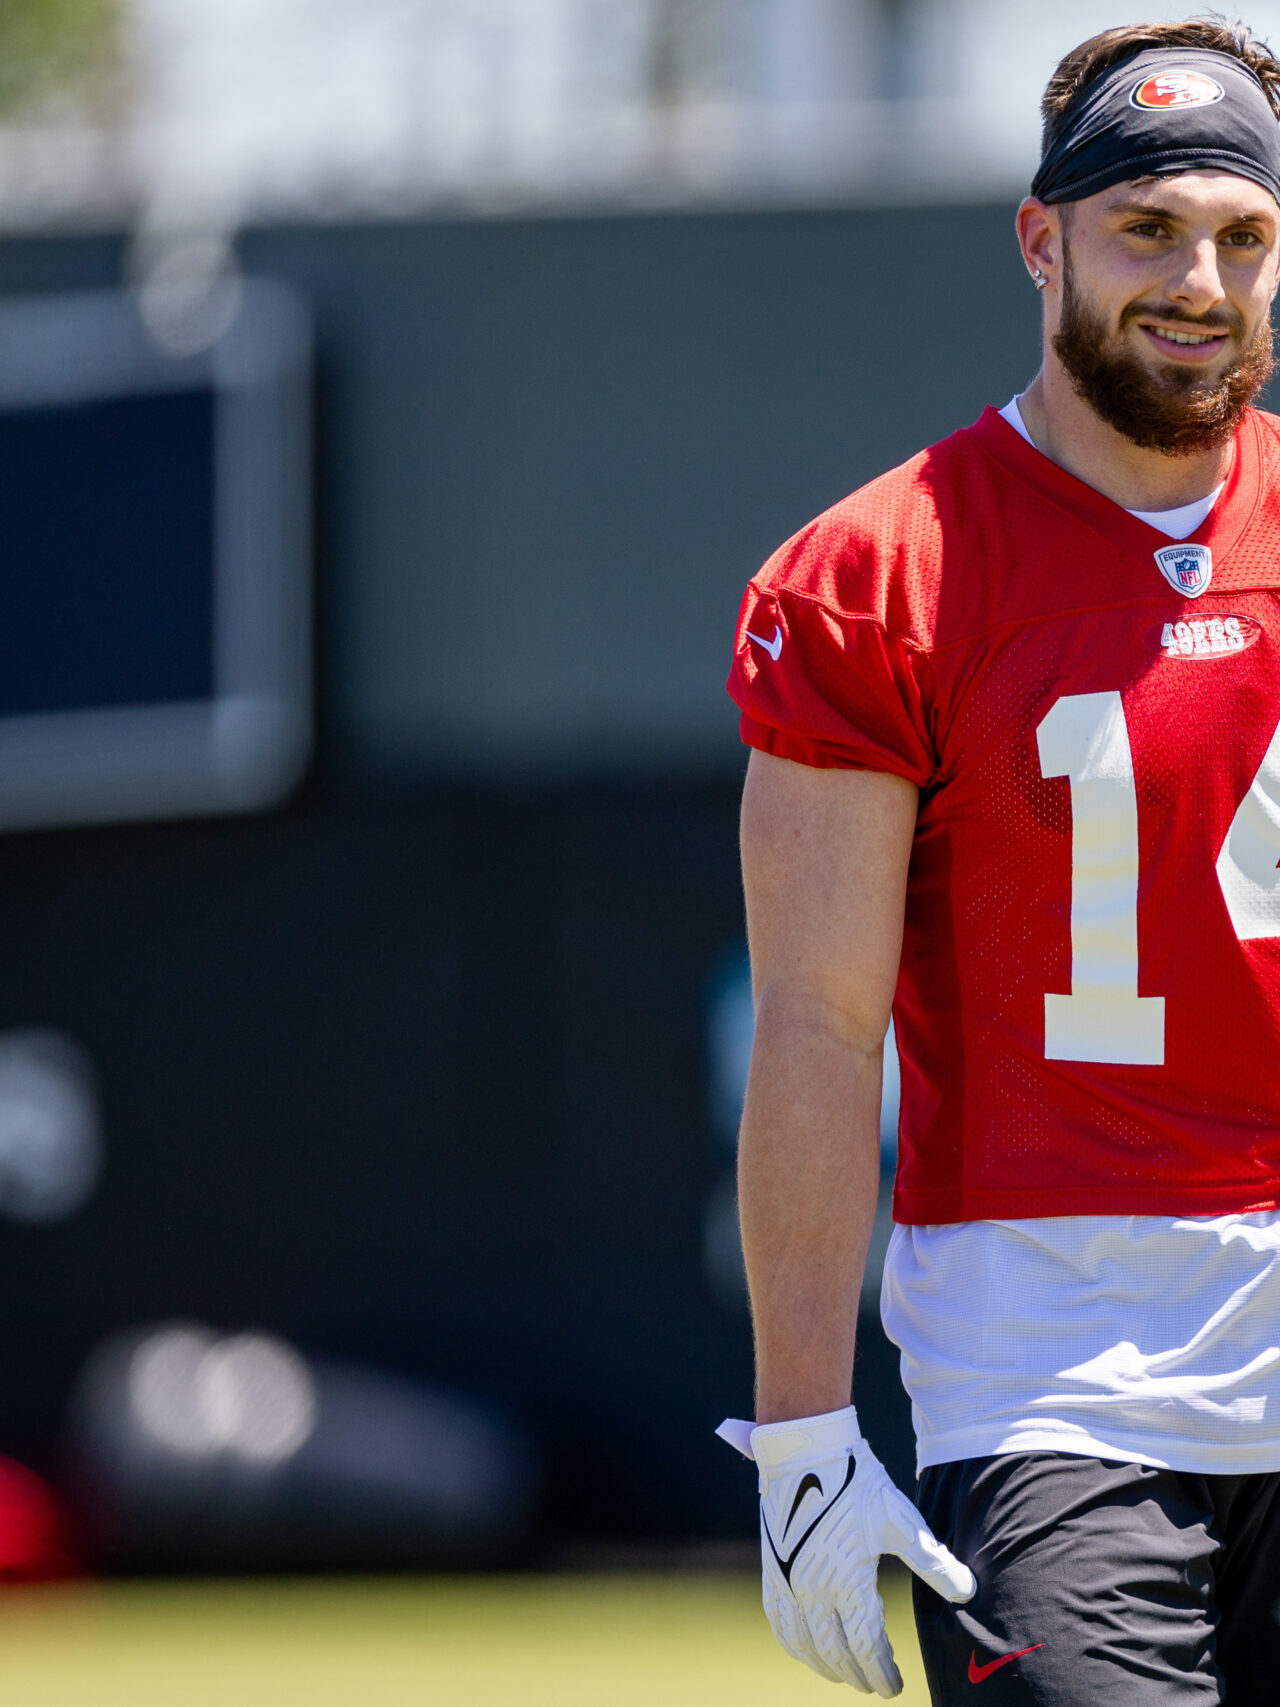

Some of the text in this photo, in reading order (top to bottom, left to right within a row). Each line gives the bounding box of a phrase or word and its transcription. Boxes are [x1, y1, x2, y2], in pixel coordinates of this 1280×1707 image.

[1163, 550, 1206, 562] EQUIPMENT
[1179, 571, 1201, 586] NFL
[1161, 617, 1245, 655] 49ERS
